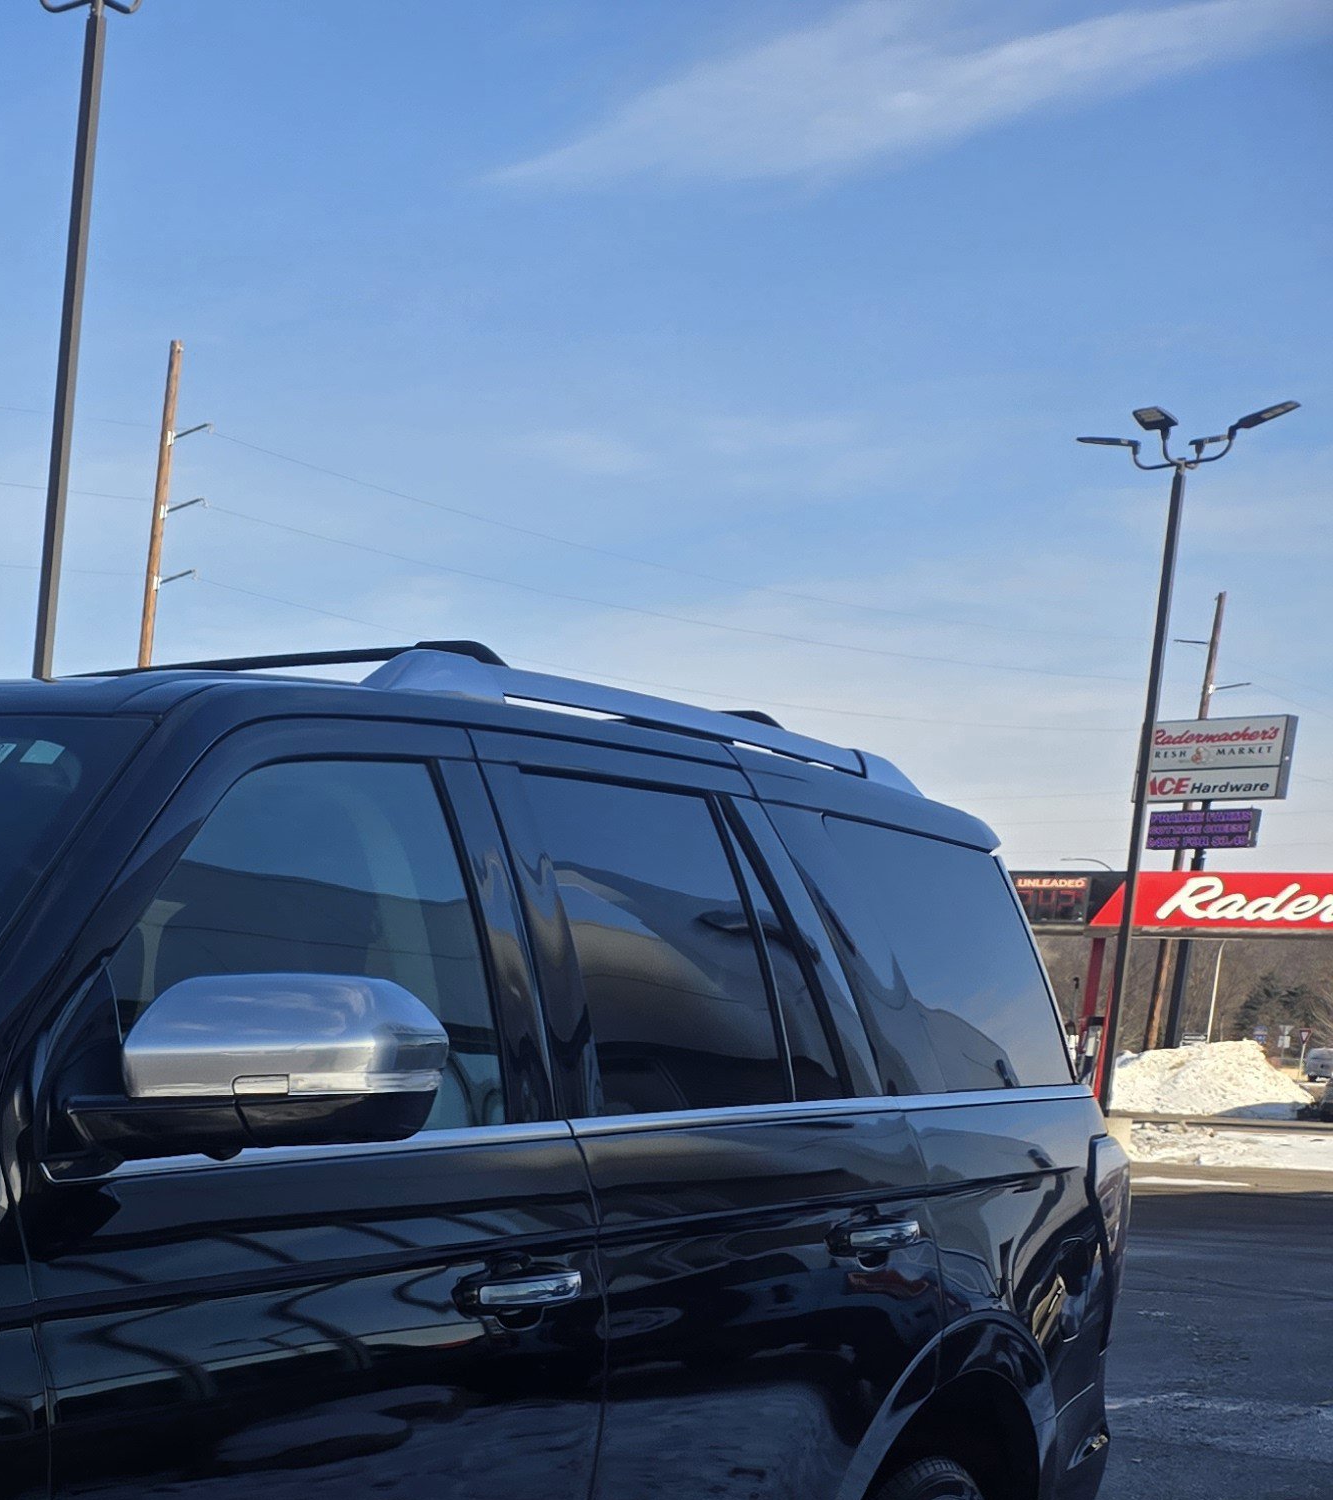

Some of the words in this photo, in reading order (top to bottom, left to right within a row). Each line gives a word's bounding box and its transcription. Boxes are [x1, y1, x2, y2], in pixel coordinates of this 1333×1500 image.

[1154, 750, 1187, 759] RESH
[1216, 746, 1273, 756] MARKET
[1189, 781, 1270, 794] Hardware
[1017, 877, 1087, 889] UNLEADED
